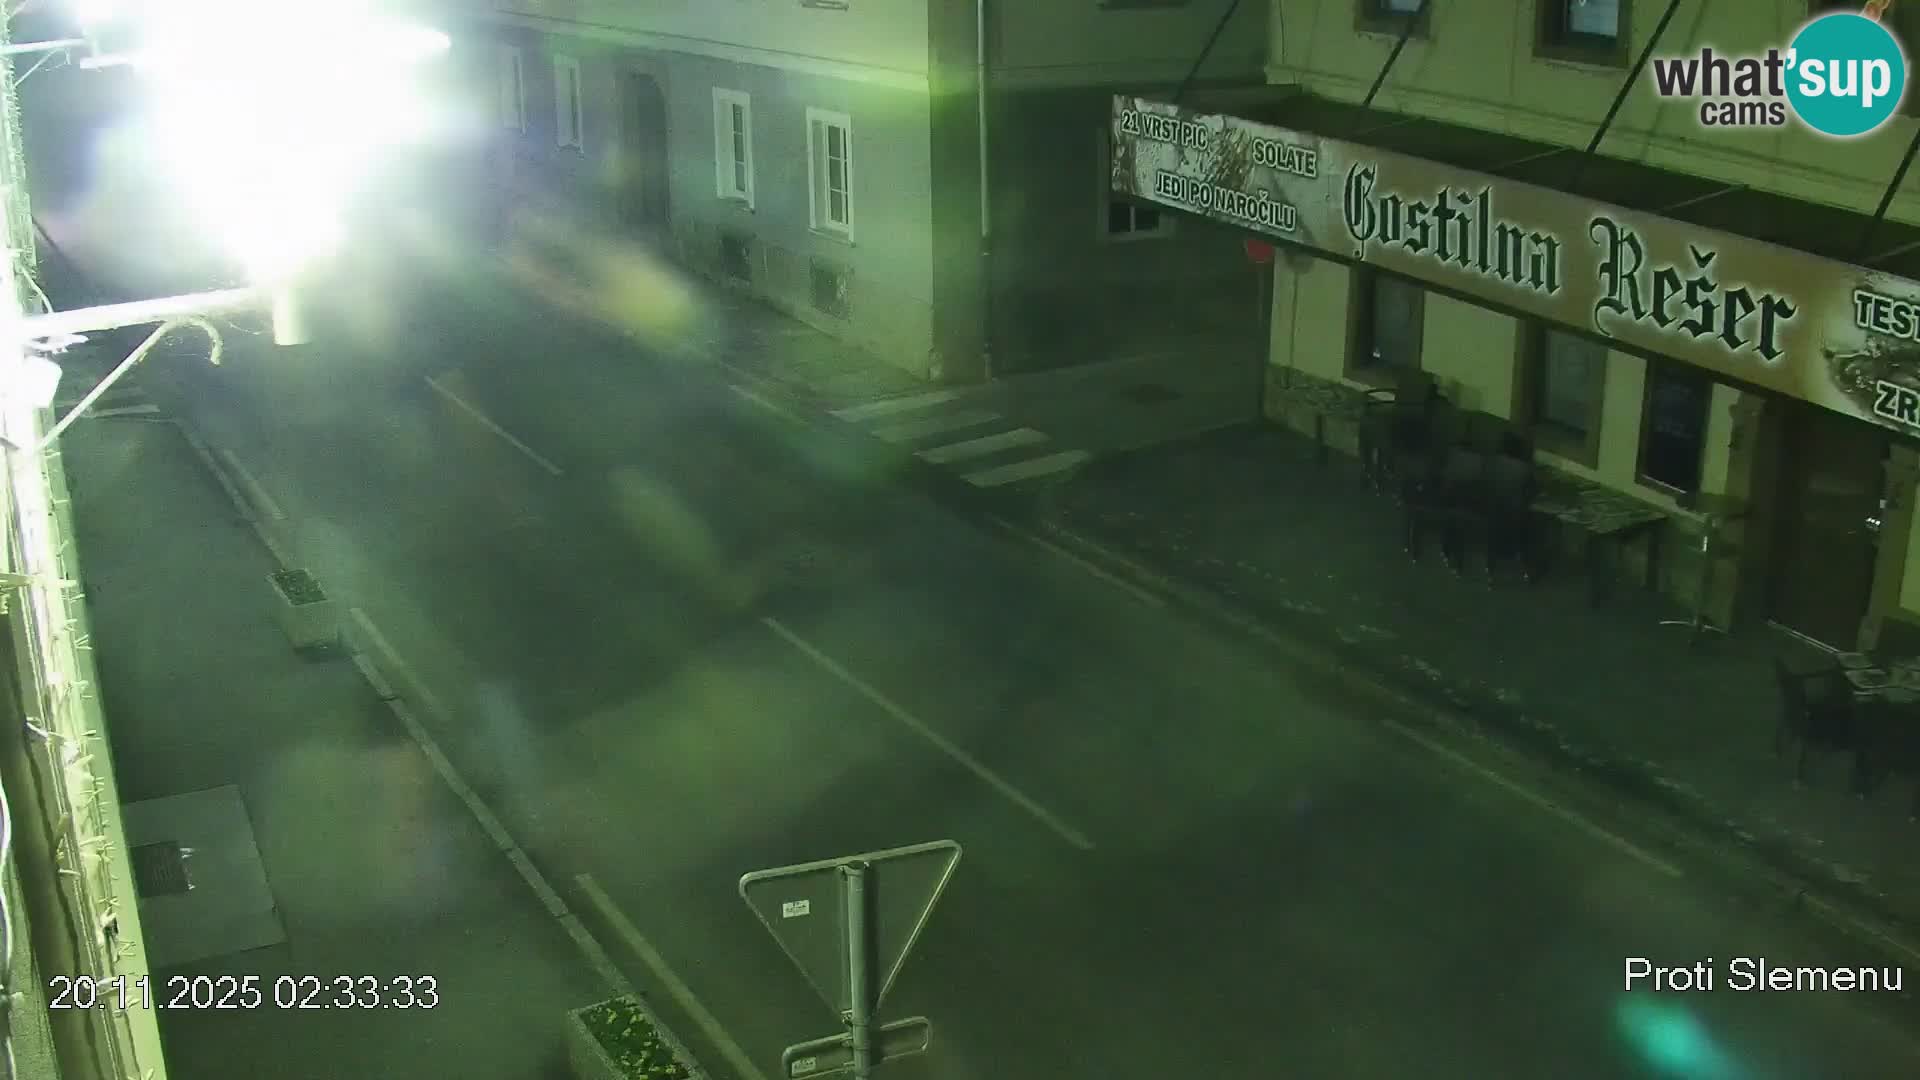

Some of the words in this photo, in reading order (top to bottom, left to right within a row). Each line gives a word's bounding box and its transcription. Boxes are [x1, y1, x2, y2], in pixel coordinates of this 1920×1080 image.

[1122, 111, 1140, 133] 21
[1142, 114, 1179, 143] VRST
[1181, 122, 1209, 150] PIC
[1253, 138, 1317, 177] SOLATE
[1155, 172, 1186, 201] JEDI
[1190, 181, 1212, 208] PO
[1214, 188, 1296, 232] NAROČILU
[1344, 161, 1561, 296] Gostilna
[1589, 217, 1798, 362] Rešer
